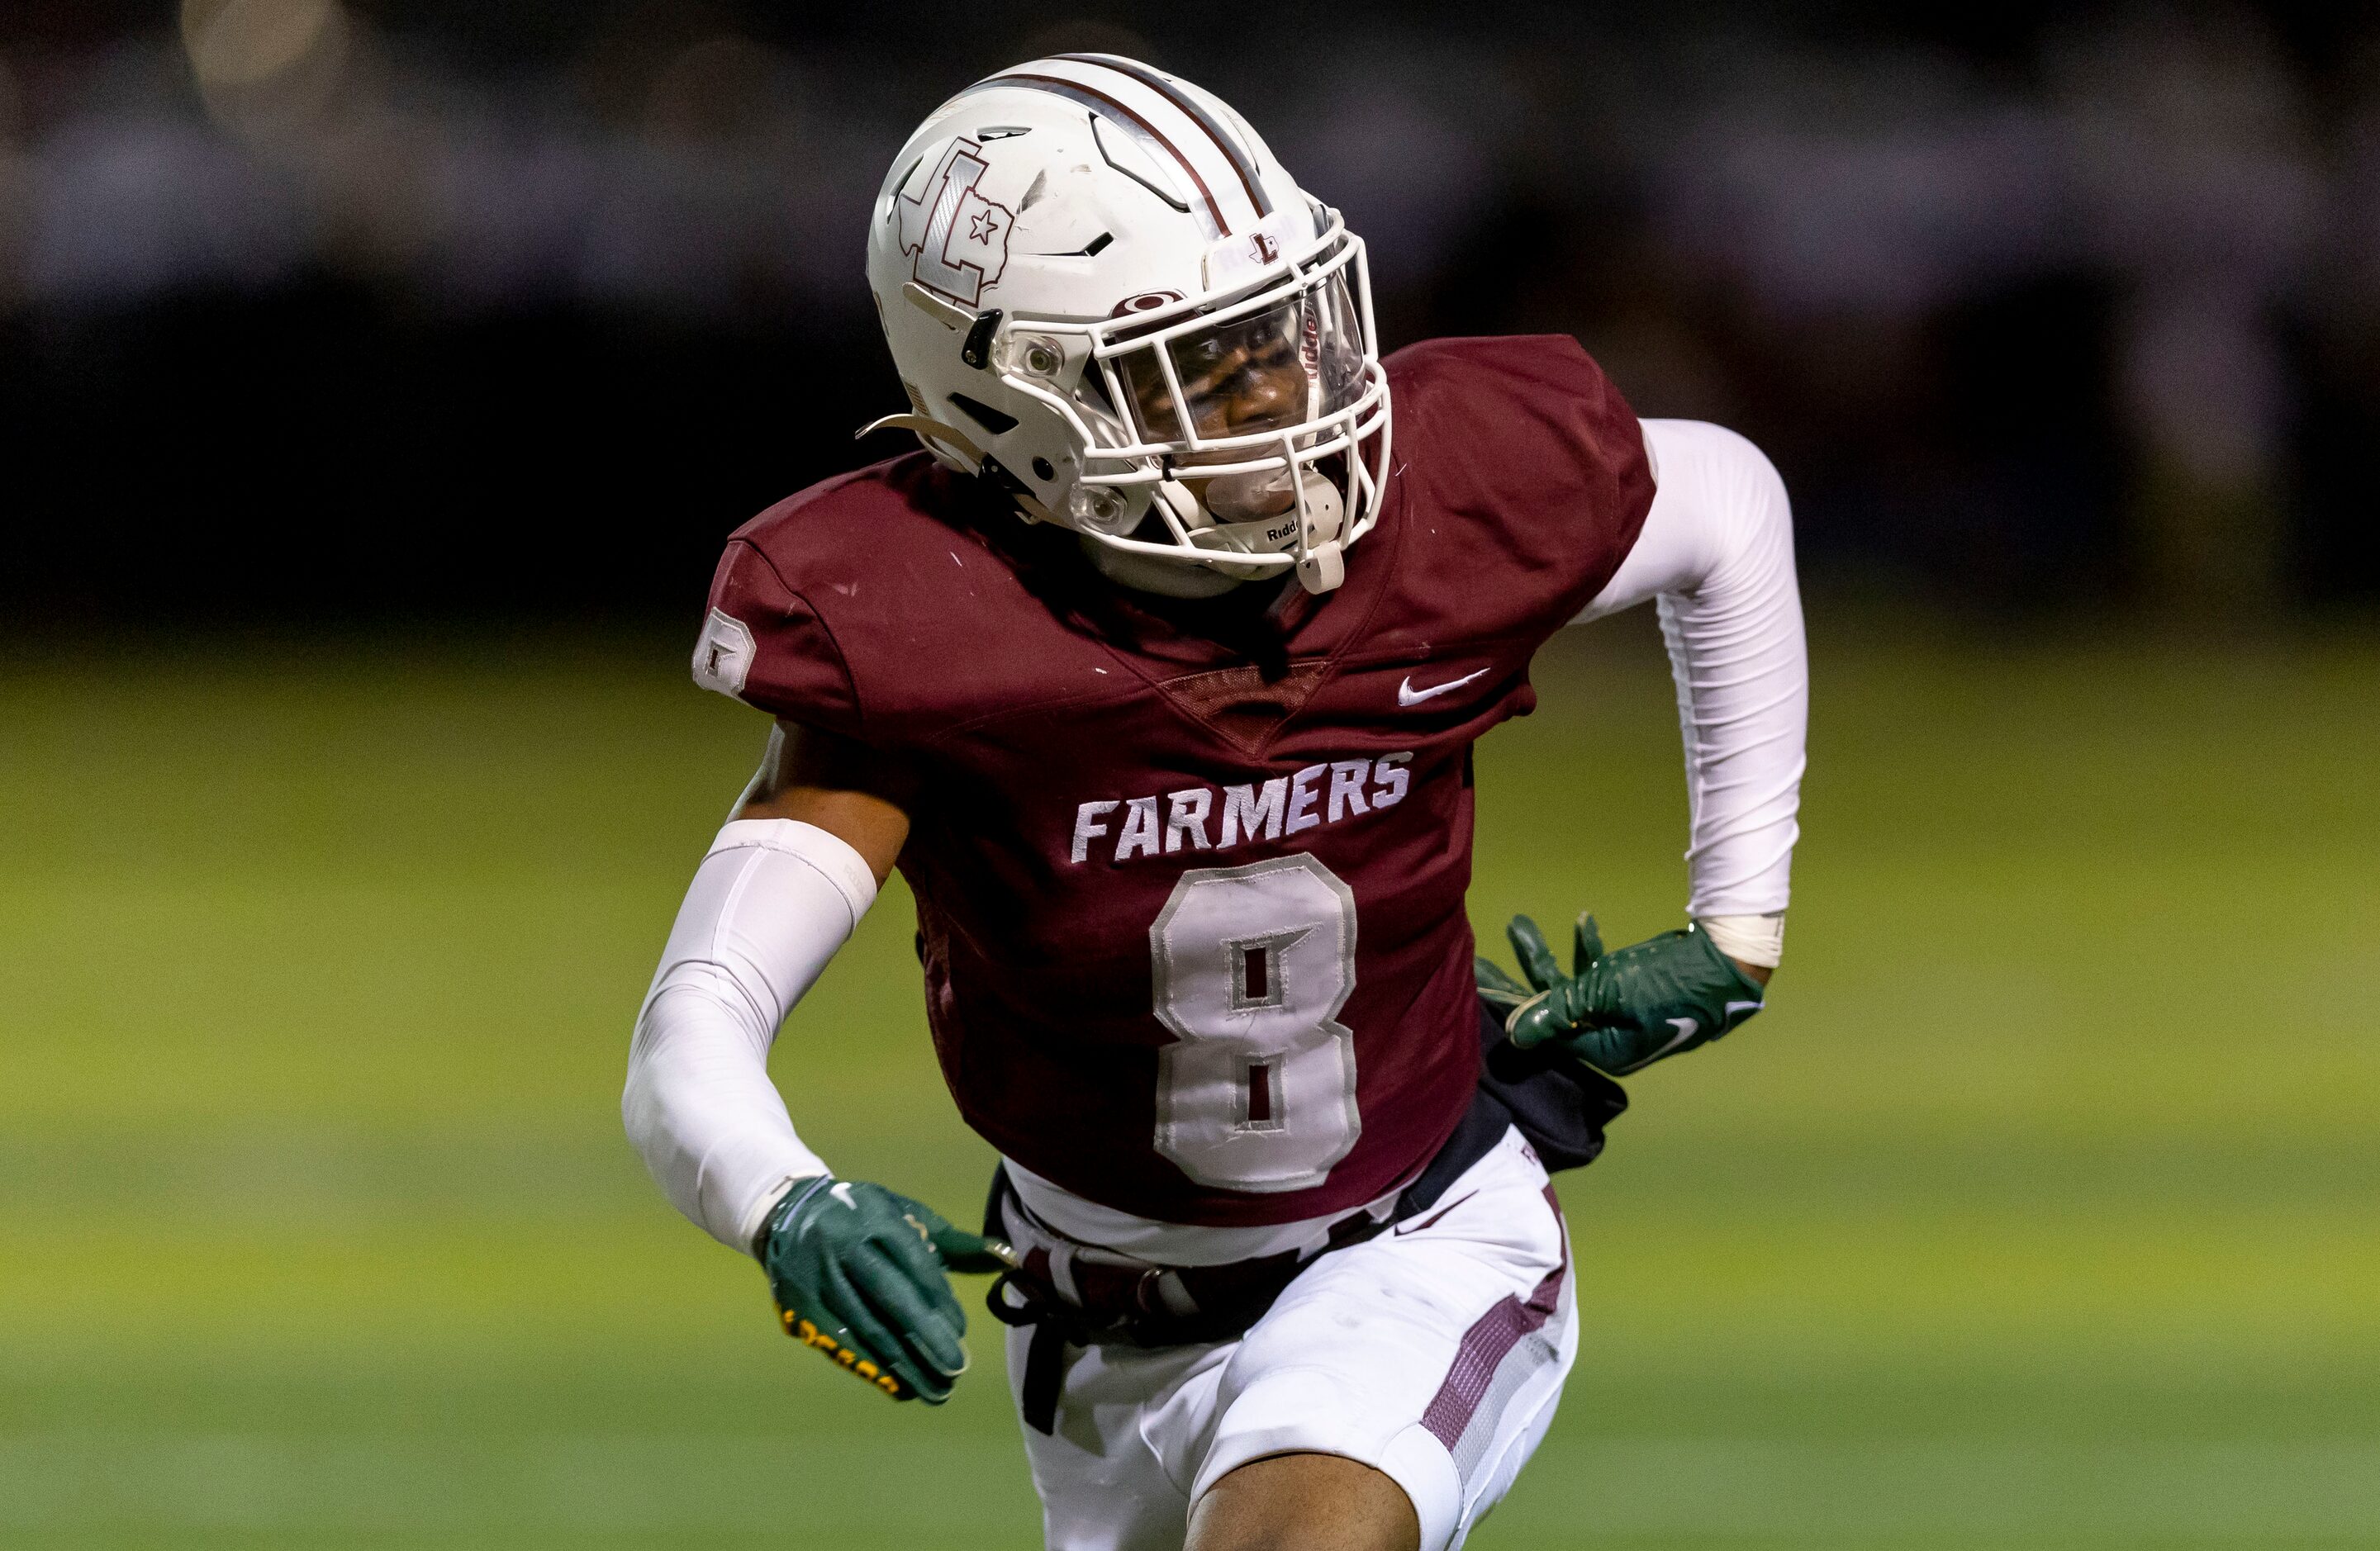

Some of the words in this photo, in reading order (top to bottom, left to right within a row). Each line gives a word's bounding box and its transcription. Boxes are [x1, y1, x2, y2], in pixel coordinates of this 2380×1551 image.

[1266, 519, 1299, 542] Ridd
[1071, 751, 1414, 864] FARMERS
[1148, 851, 1362, 1193] 8
